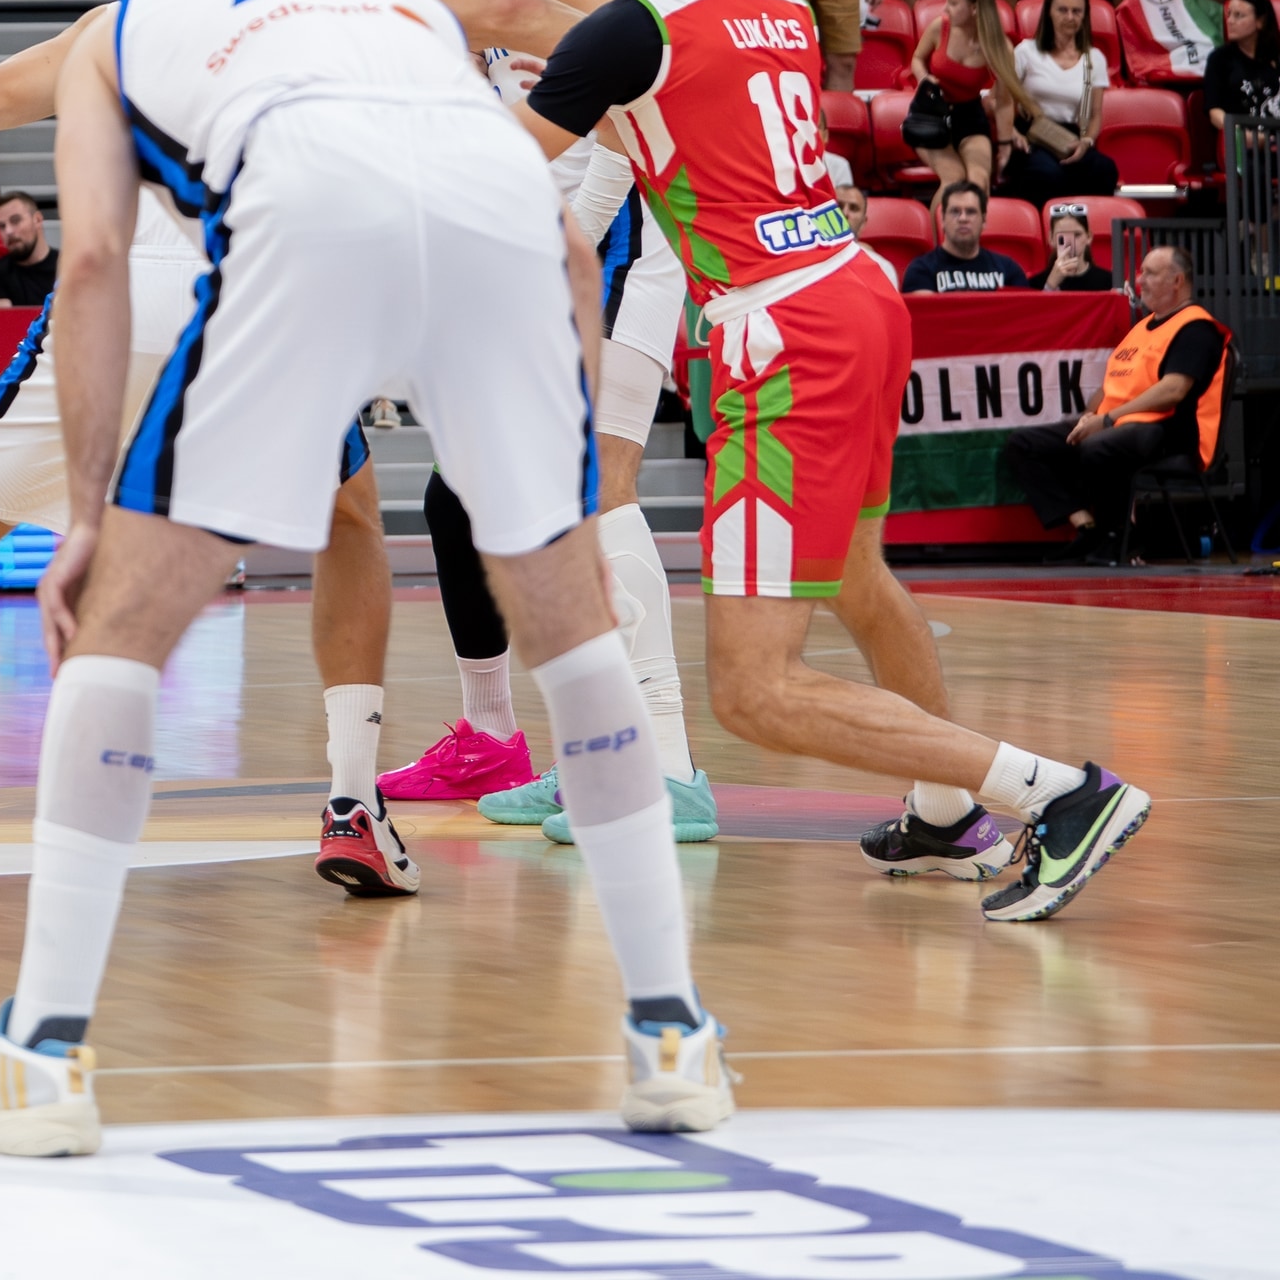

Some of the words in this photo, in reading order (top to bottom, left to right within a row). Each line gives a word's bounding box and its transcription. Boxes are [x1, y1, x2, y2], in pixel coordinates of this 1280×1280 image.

[722, 12, 809, 50] LUKÁCS
[747, 71, 827, 197] 18
[936, 270, 966, 293] OLD
[967, 271, 1005, 289] NAVY
[563, 726, 637, 757] cep
